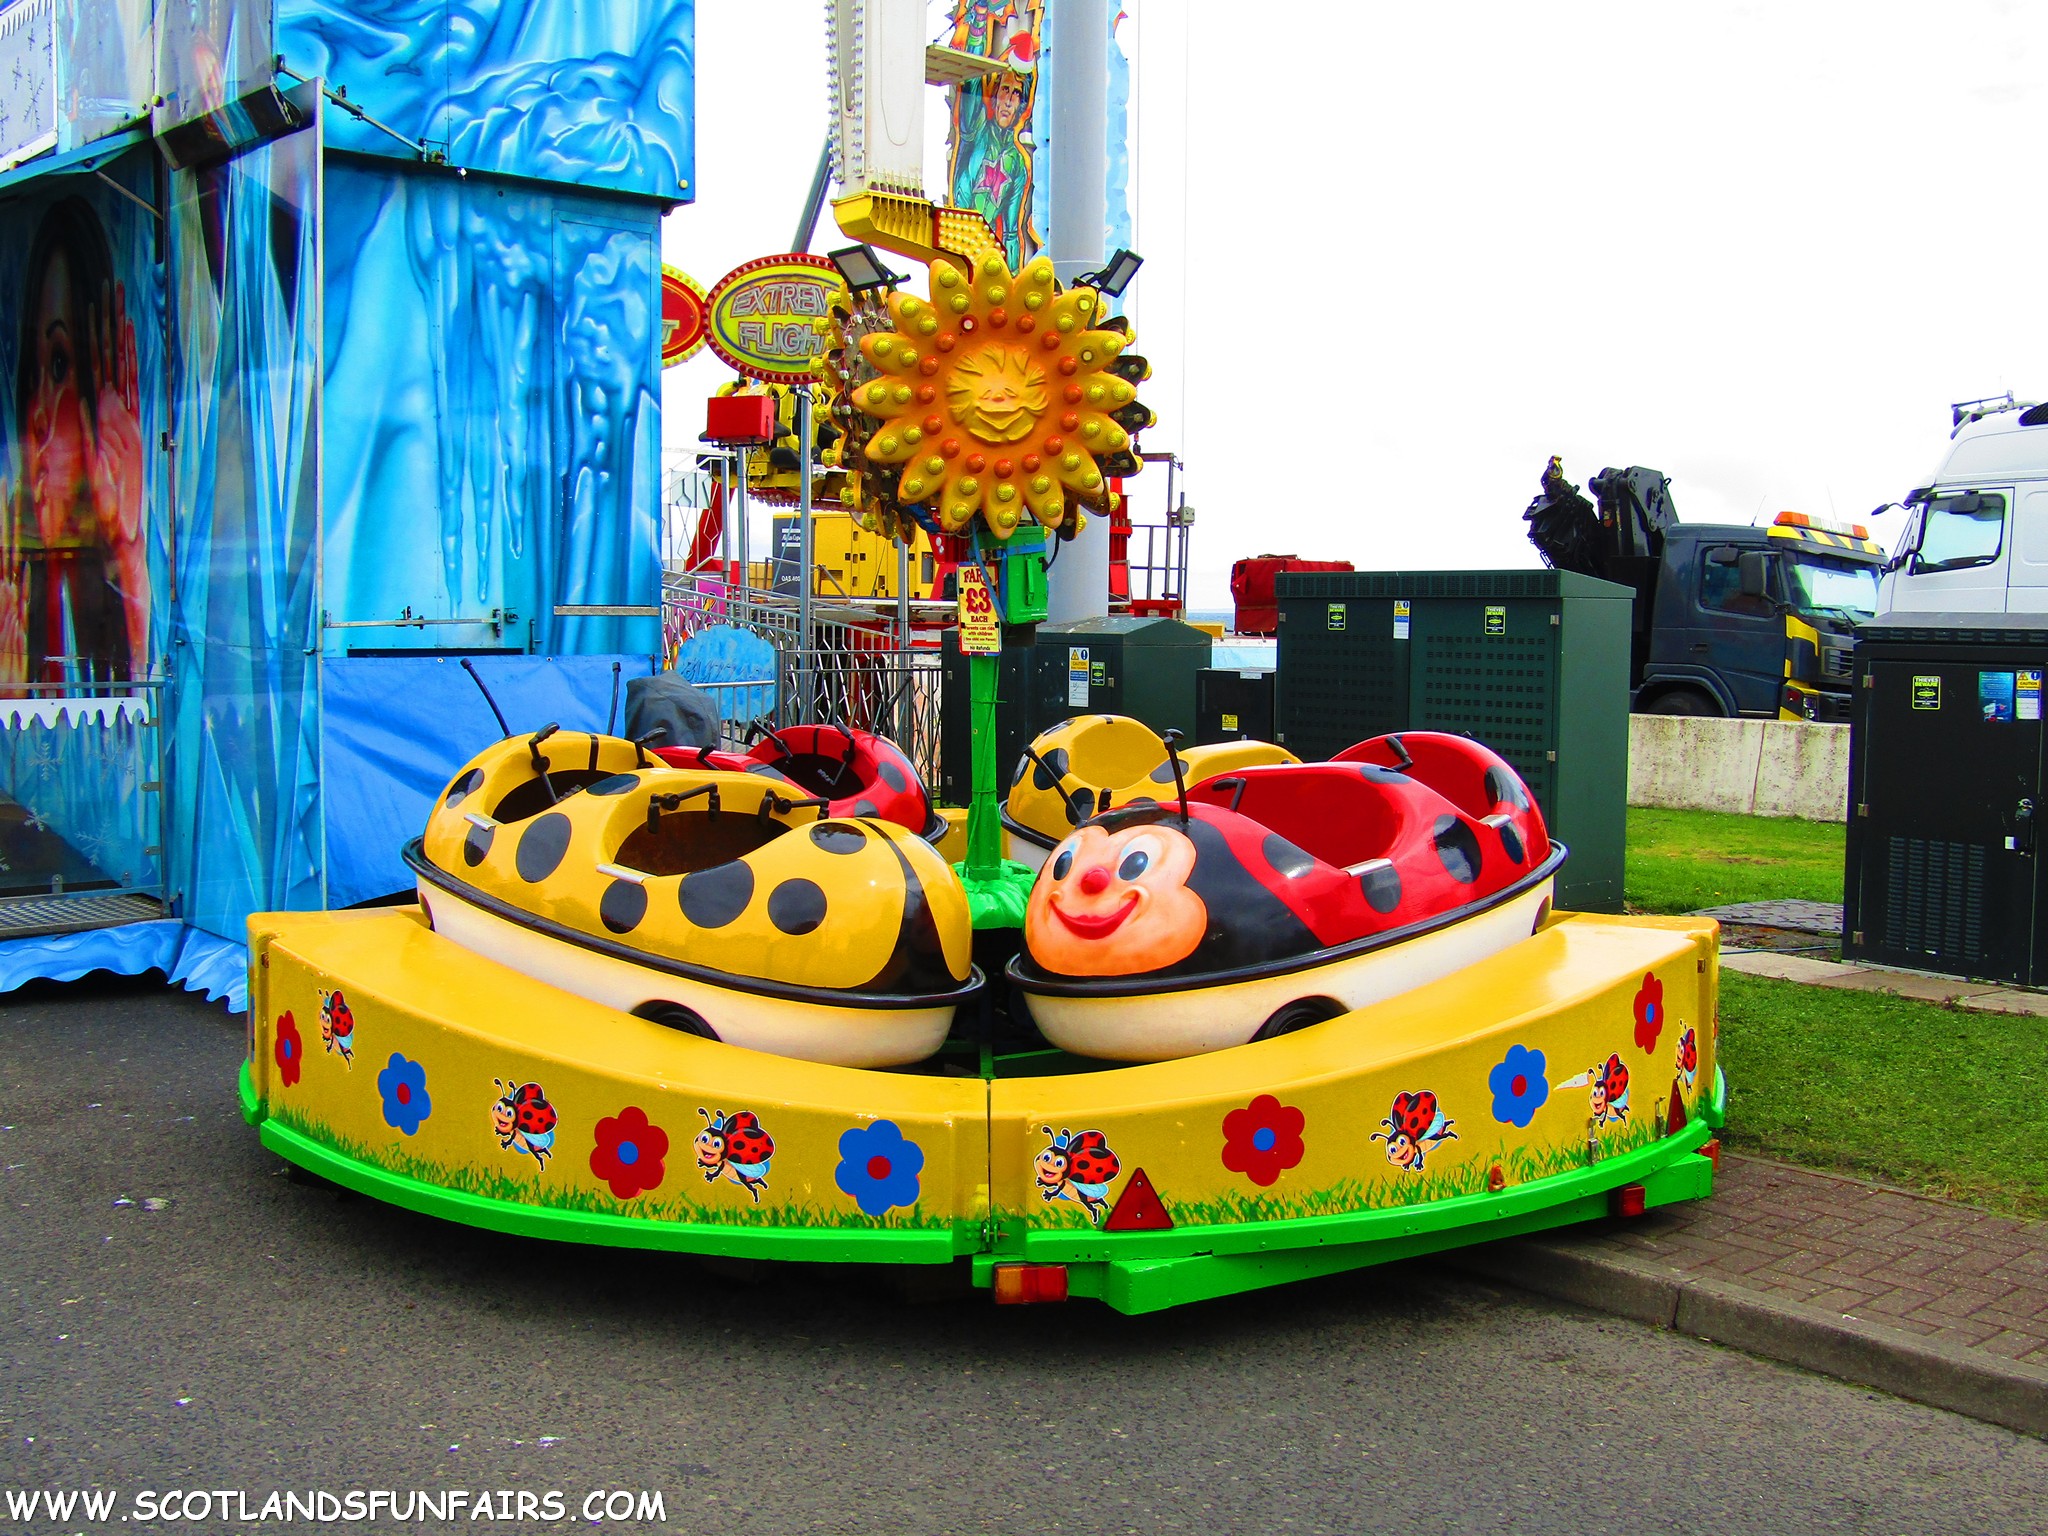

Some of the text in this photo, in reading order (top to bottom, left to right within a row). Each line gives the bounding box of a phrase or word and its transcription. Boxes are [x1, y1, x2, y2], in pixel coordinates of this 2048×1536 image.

[731, 283, 830, 317] EXTREM
[739, 321, 824, 356] FLIGH
[966, 588, 992, 614] £3
